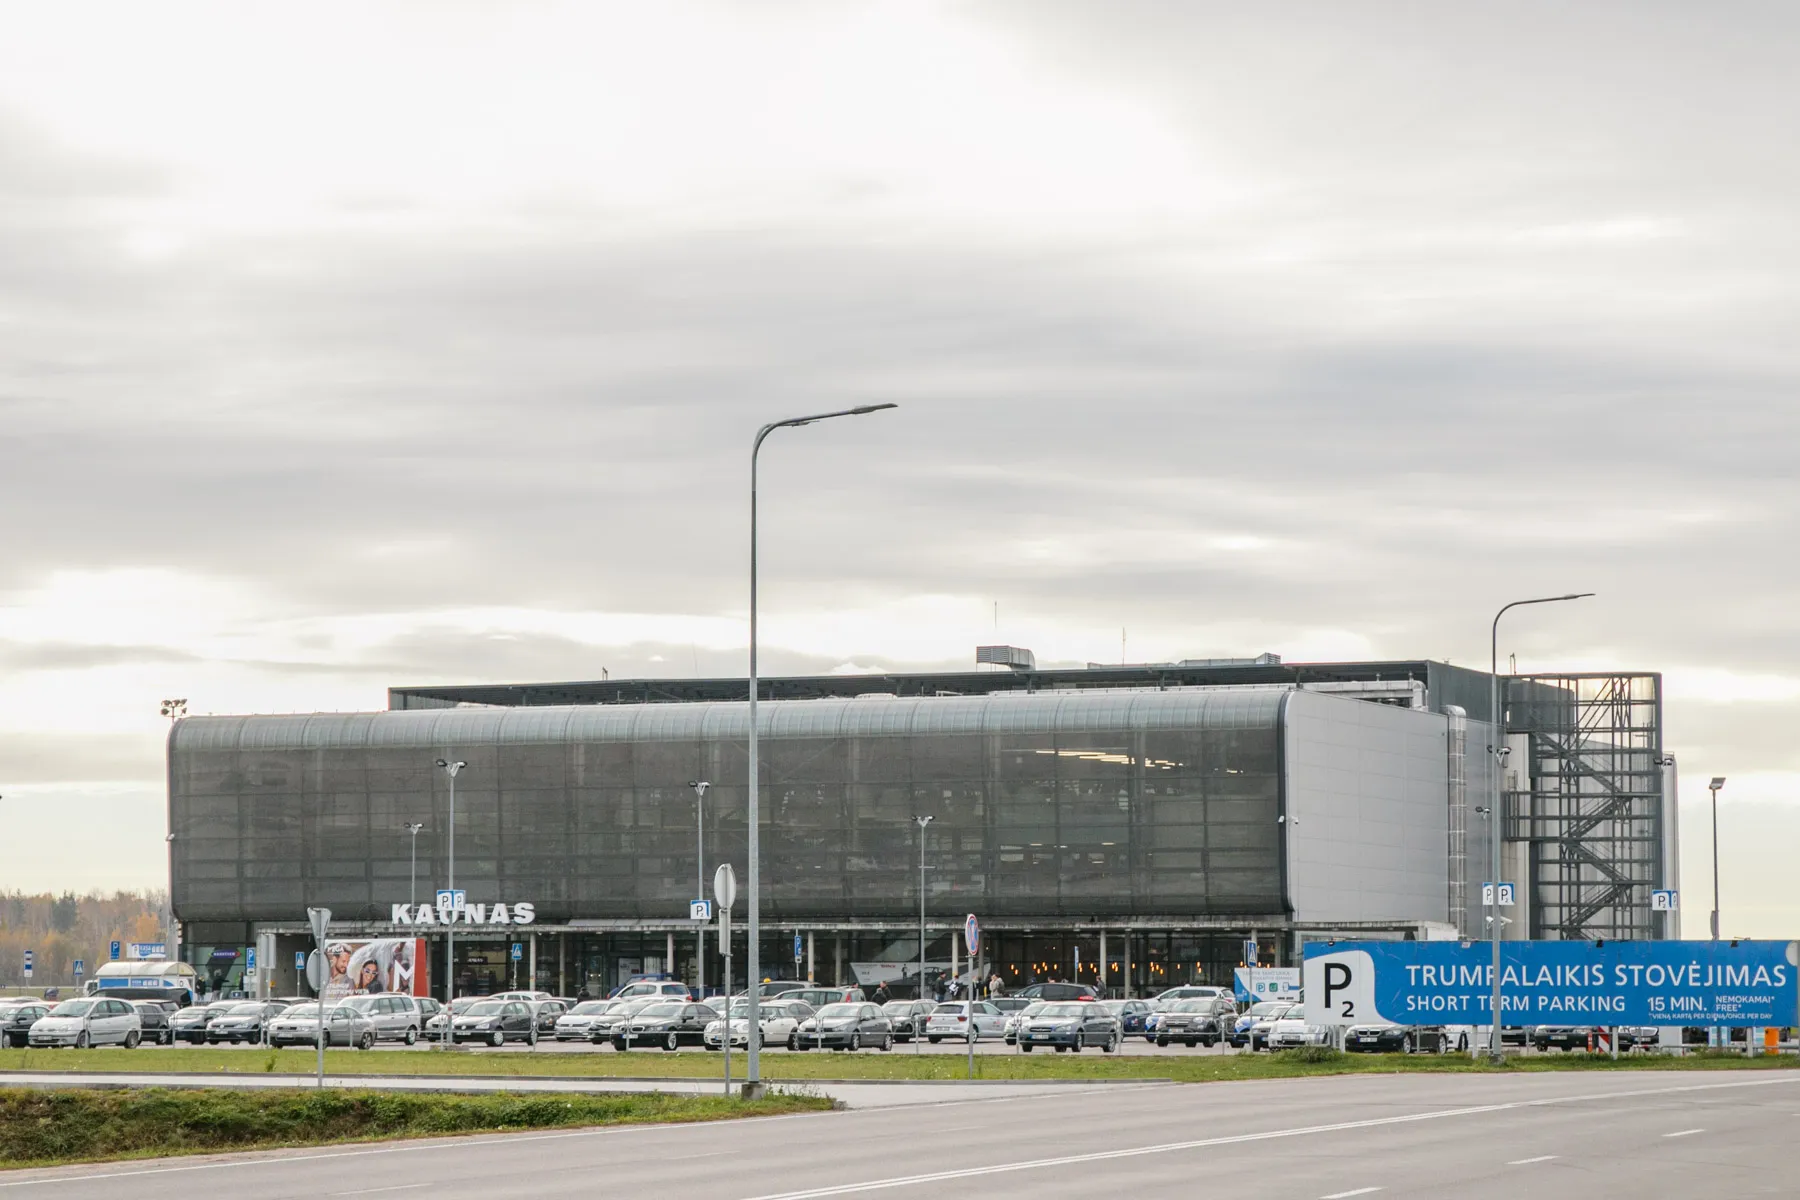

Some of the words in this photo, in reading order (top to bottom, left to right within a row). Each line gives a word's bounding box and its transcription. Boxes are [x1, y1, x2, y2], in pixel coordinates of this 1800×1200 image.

[391, 902, 536, 925] KAUNAS
[1405, 964, 1604, 987] TRUMPALAIKIS
[1615, 960, 1786, 987] STOVĖJIMAS
[1406, 995, 1470, 1011] SHORT
[1477, 995, 1529, 1011] TERM
[1538, 995, 1625, 1012] PARKING
[1647, 996, 1666, 1012] 15
[1670, 996, 1707, 1012] MIN.
